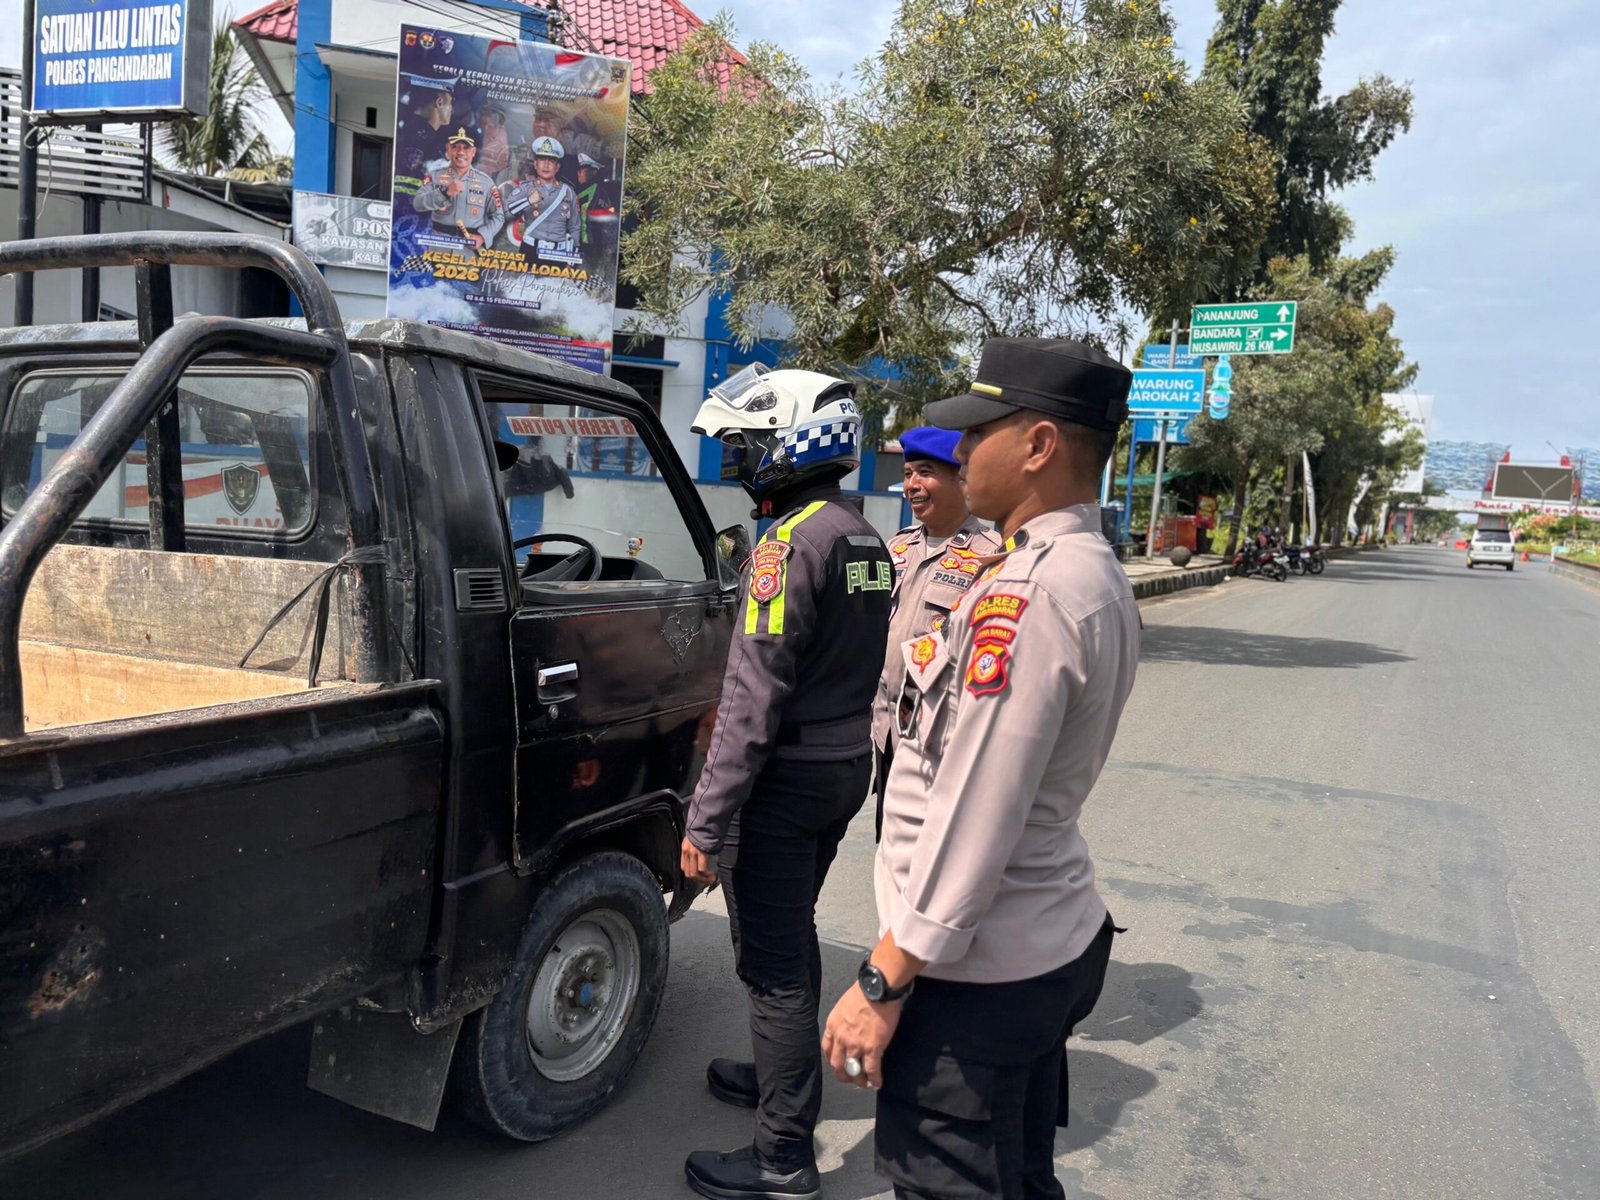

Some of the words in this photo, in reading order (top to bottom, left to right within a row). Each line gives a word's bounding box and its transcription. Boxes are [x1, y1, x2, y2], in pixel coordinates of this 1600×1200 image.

[40, 12, 93, 55] SATUAN
[95, 9, 129, 51] LALU
[130, 3, 182, 48] LINTAS
[45, 58, 86, 86] POLRES
[87, 52, 172, 83] PANGANDARAN
[320, 235, 384, 251] KAWASAN
[354, 251, 384, 264] KAB.
[480, 248, 526, 262] OPERASI
[422, 250, 528, 273] KESELAMATAN
[531, 263, 588, 281] LODAYA
[433, 263, 480, 282] 2026
[494, 297, 525, 306] FEBRUARI
[1196, 309, 1259, 322] PANANJUNG
[1193, 328, 1242, 339] BANDARA
[1192, 341, 1243, 353] NUSAWIRU
[1244, 341, 1256, 352] 26
[1258, 340, 1274, 352] KM
[1147, 352, 1179, 360] WARUG
[1151, 358, 1188, 366] BAROAH
[1132, 379, 1194, 391] WARUNG
[1192, 391, 1201, 402] 2
